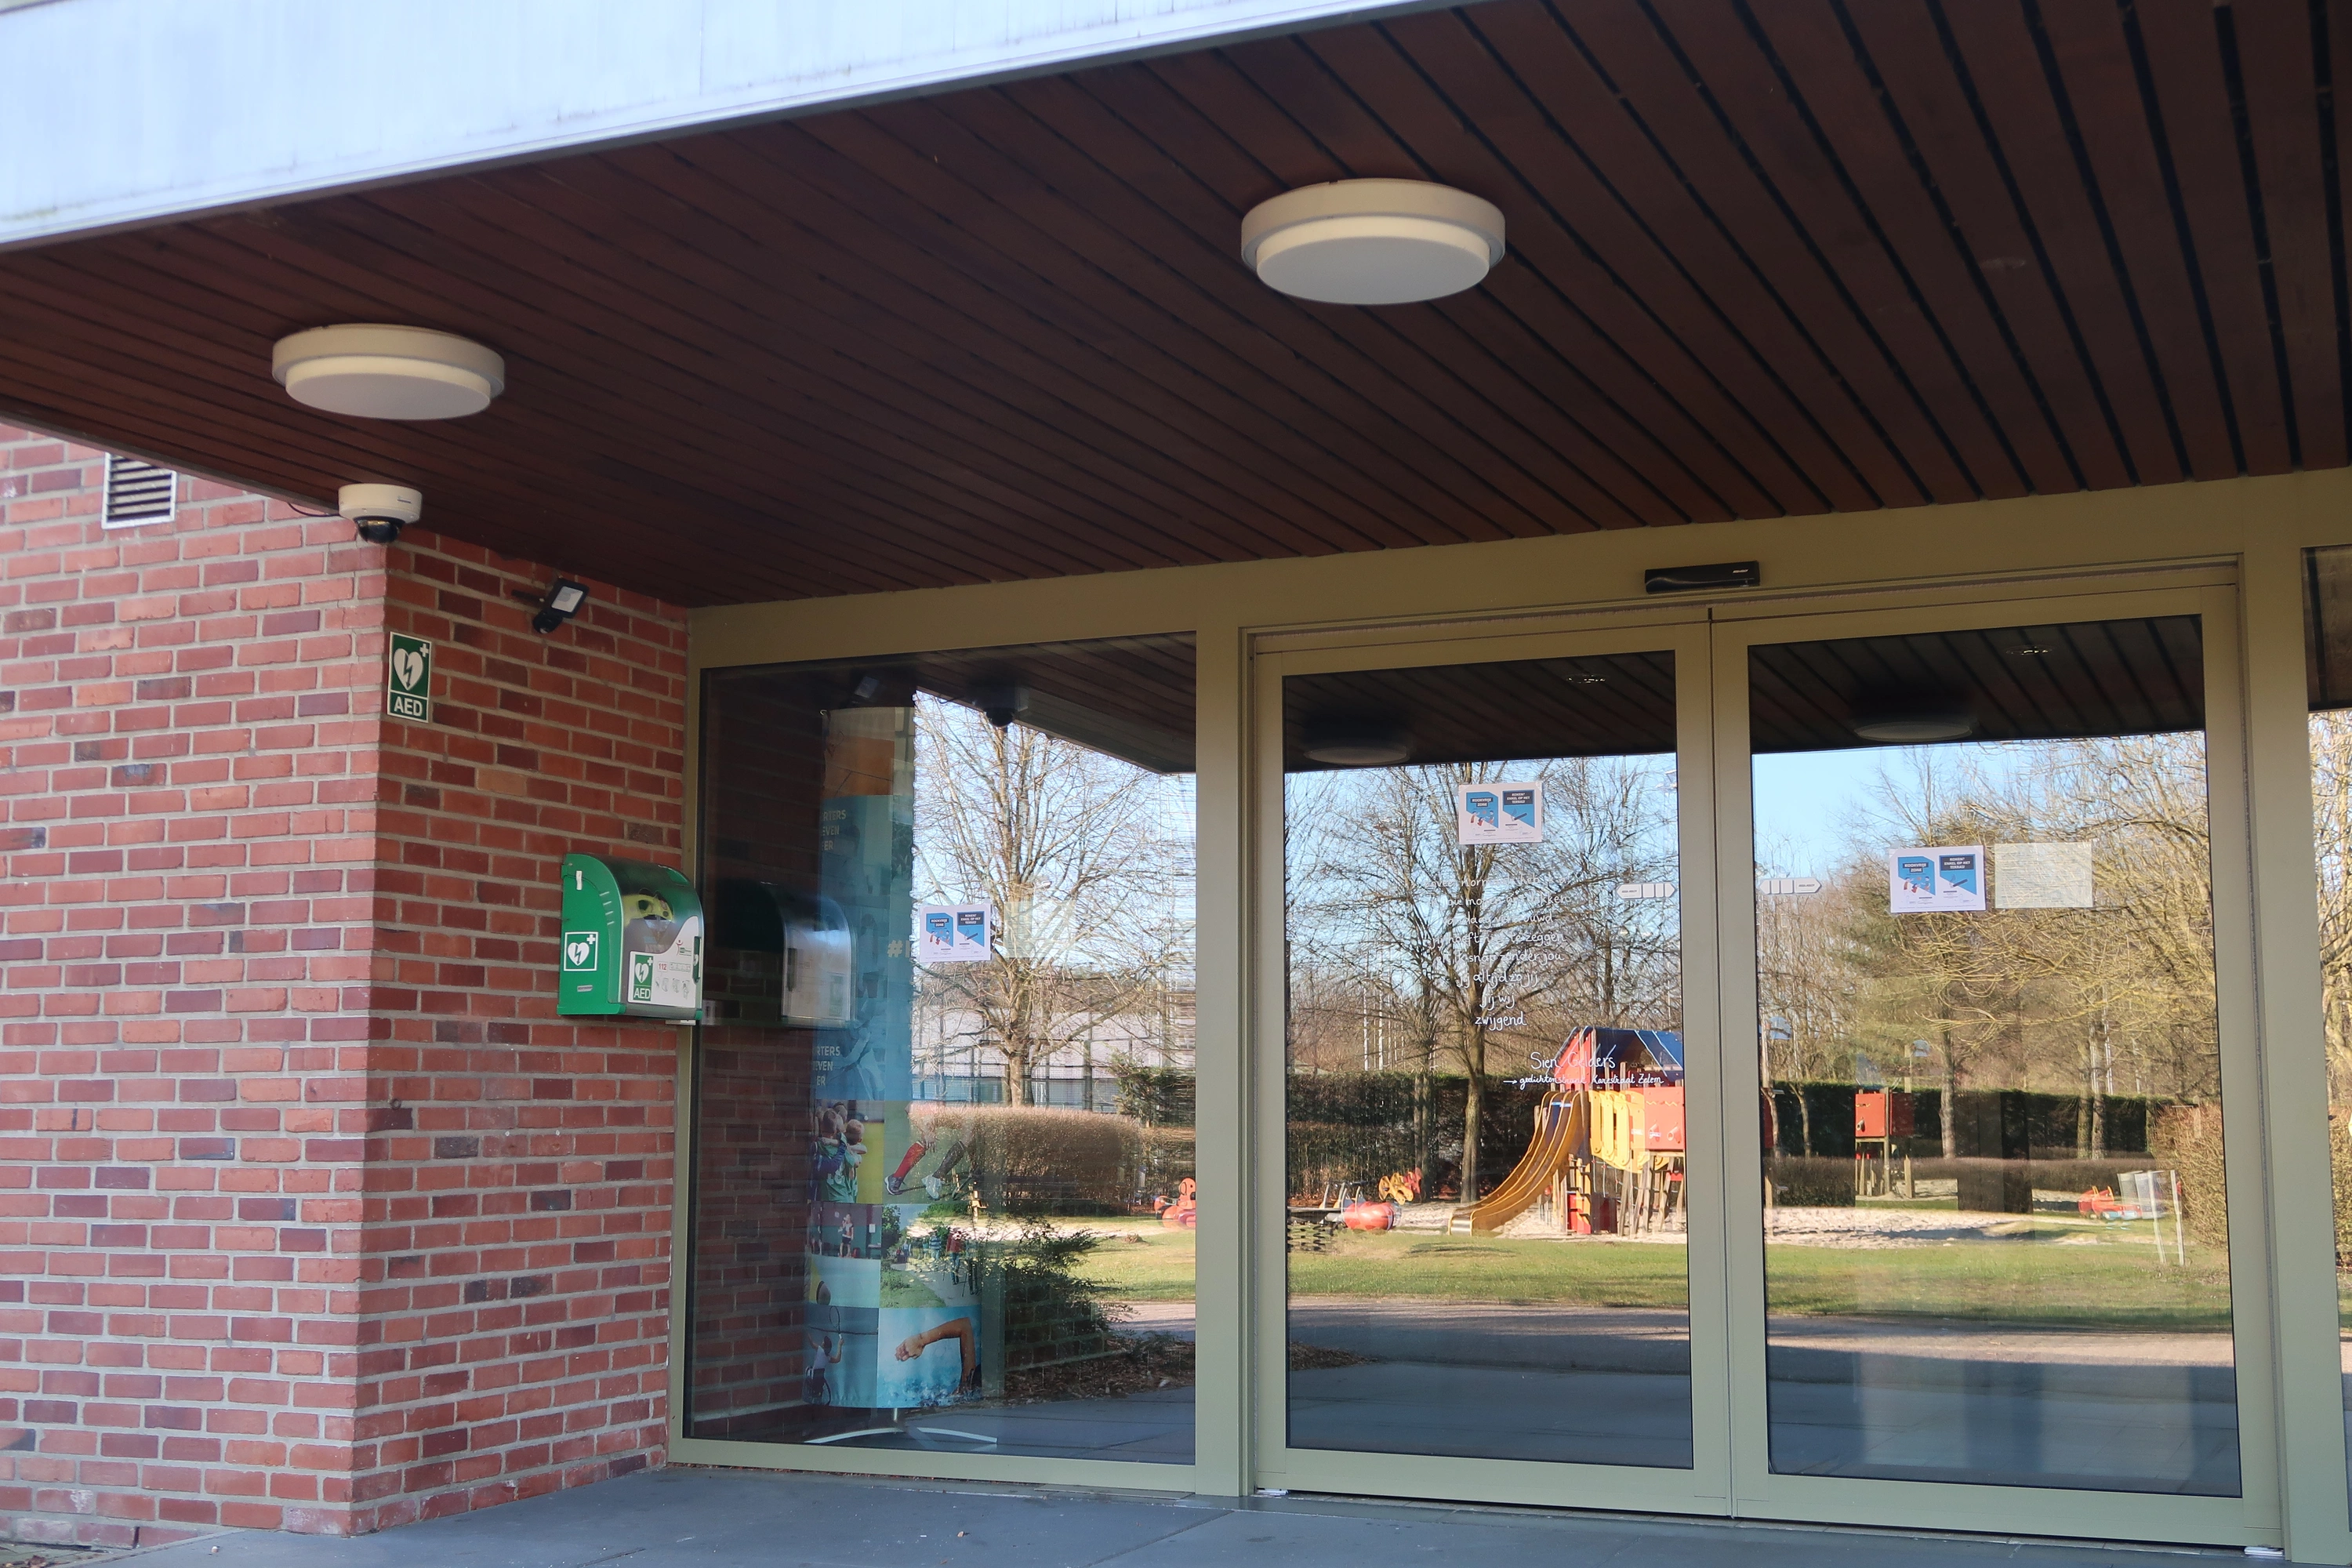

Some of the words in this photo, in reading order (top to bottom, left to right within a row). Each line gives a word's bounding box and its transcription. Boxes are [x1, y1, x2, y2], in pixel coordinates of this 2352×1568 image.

[394, 696, 423, 717] AED
[1526, 932, 1566, 947] zeggen
[1468, 954, 1498, 967] snap
[1499, 949, 1540, 961] zonder
[1540, 951, 1565, 966] jou
[633, 988, 651, 999] AED
[1498, 993, 1515, 1009] wij
[1475, 1011, 1527, 1031] zwijgend
[1530, 1051, 1561, 1069] Sien
[1568, 1051, 1616, 1069] Gelders
[1638, 1073, 1664, 1084] Zelem
